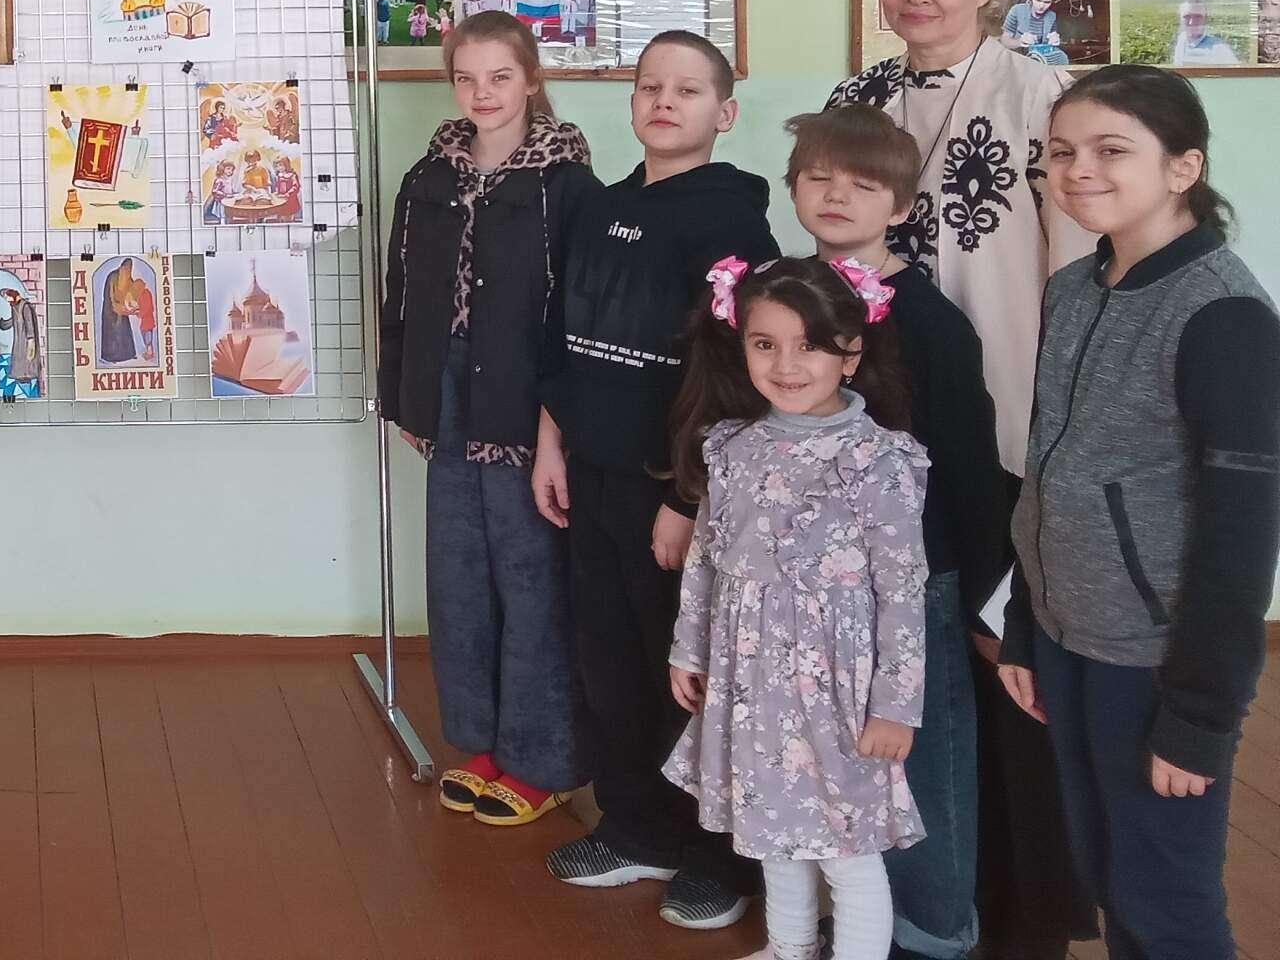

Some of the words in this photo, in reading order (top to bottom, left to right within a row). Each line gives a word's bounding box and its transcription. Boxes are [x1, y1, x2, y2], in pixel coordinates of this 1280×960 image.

[73, 270, 90, 367] ДЕНЬ
[162, 256, 174, 376] ПРАВОСЛАВНОЙ
[92, 371, 164, 391] КНИГИ
